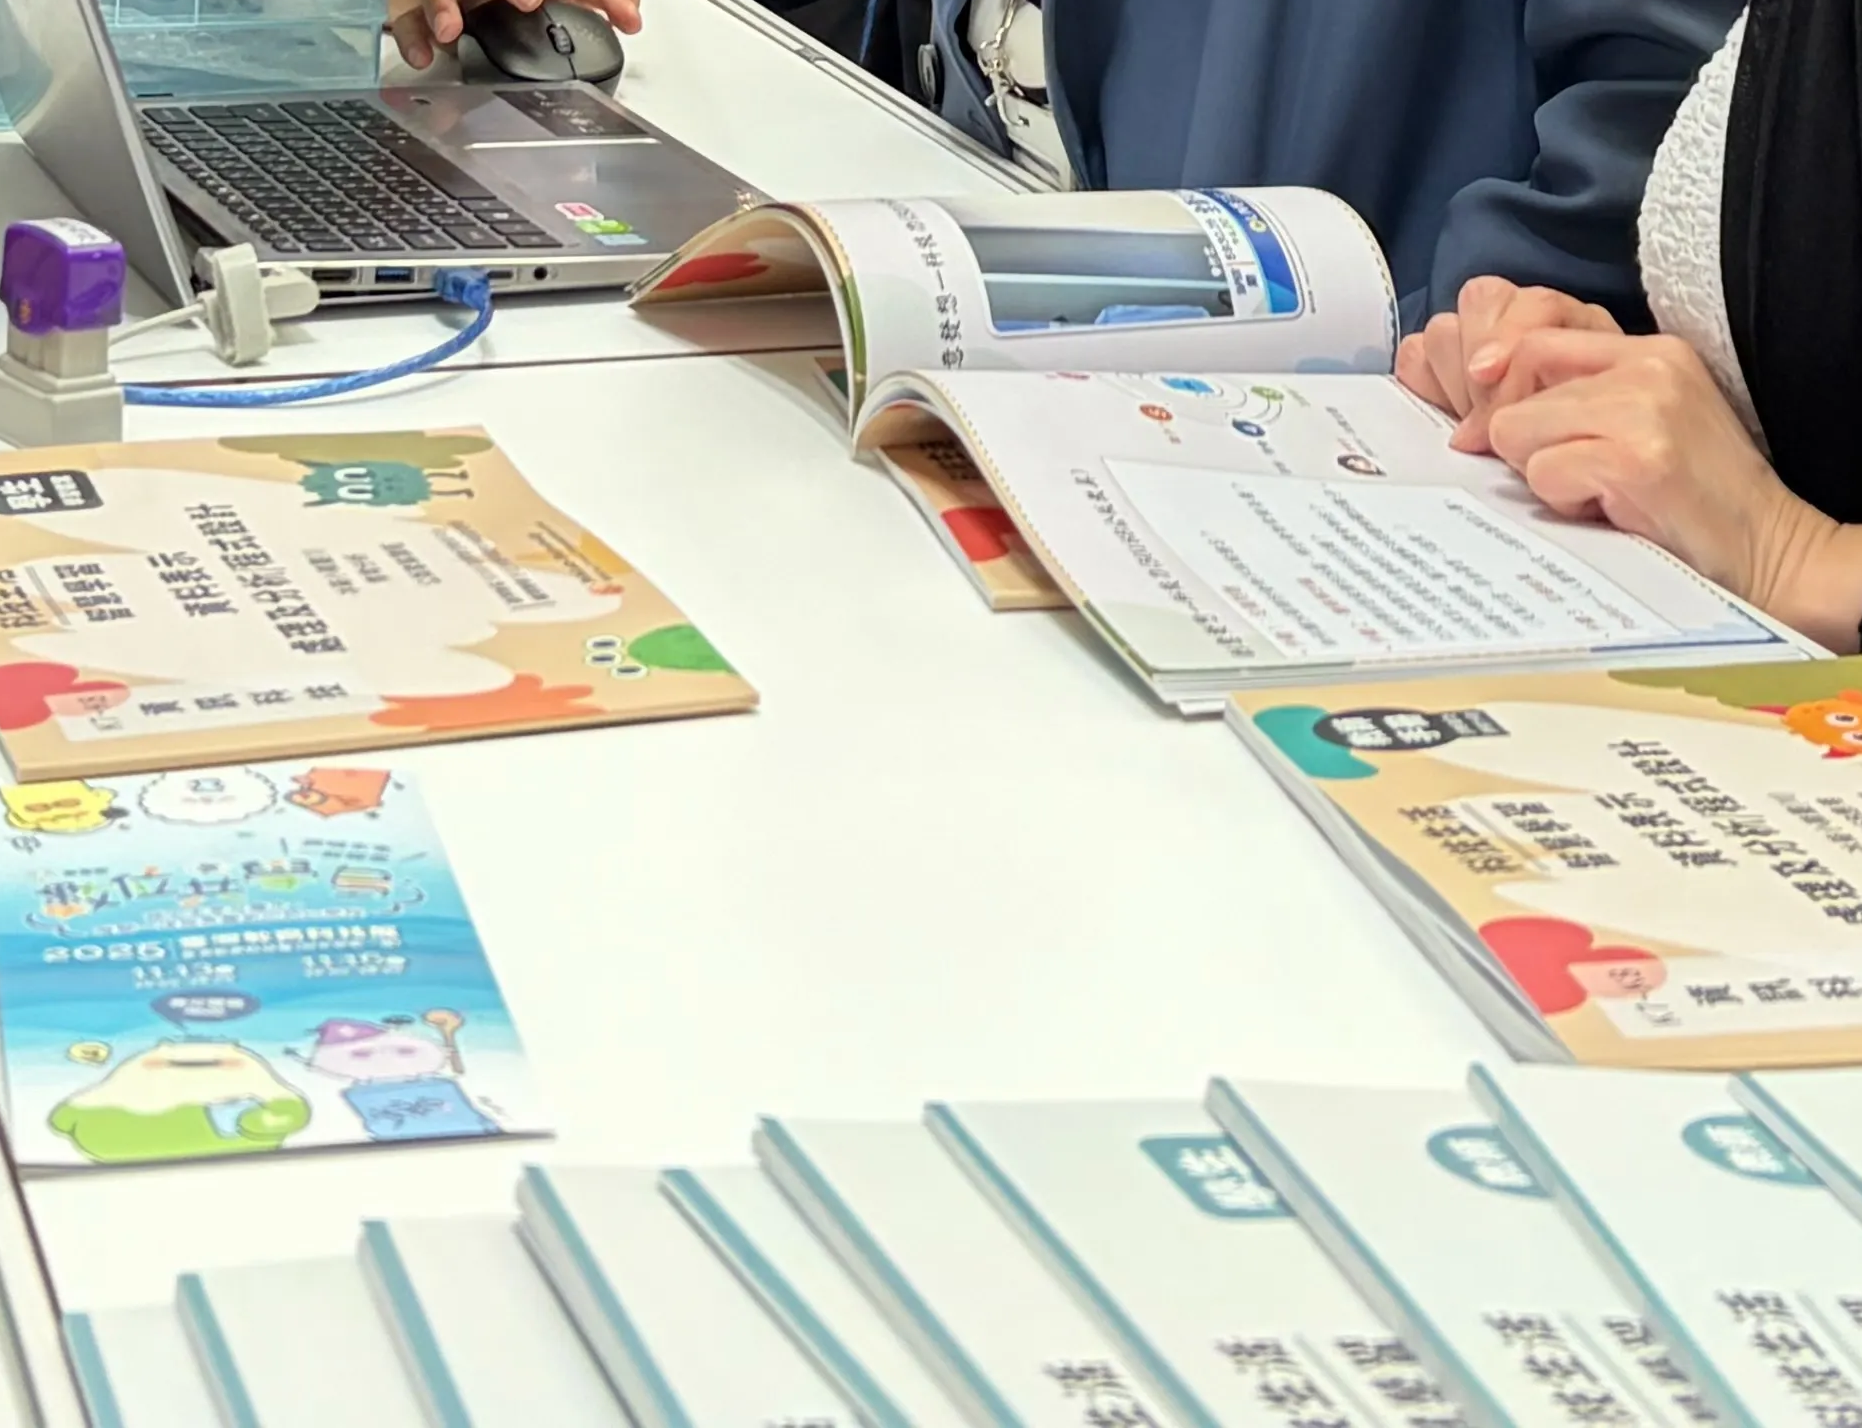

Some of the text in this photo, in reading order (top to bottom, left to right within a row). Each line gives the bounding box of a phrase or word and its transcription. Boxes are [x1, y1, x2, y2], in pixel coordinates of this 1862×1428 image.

[60, 560, 138, 624] 智慧學習
[148, 548, 239, 621] 資料表示
[185, 501, 348, 657] 處理及分析/程式設計
[138, 681, 351, 719] 資訊科技
[1398, 803, 1522, 877] 科技生活
[1492, 799, 1624, 871] 智慧學習
[1593, 791, 1743, 873] 資料表示
[42, 942, 167, 963] 2025
